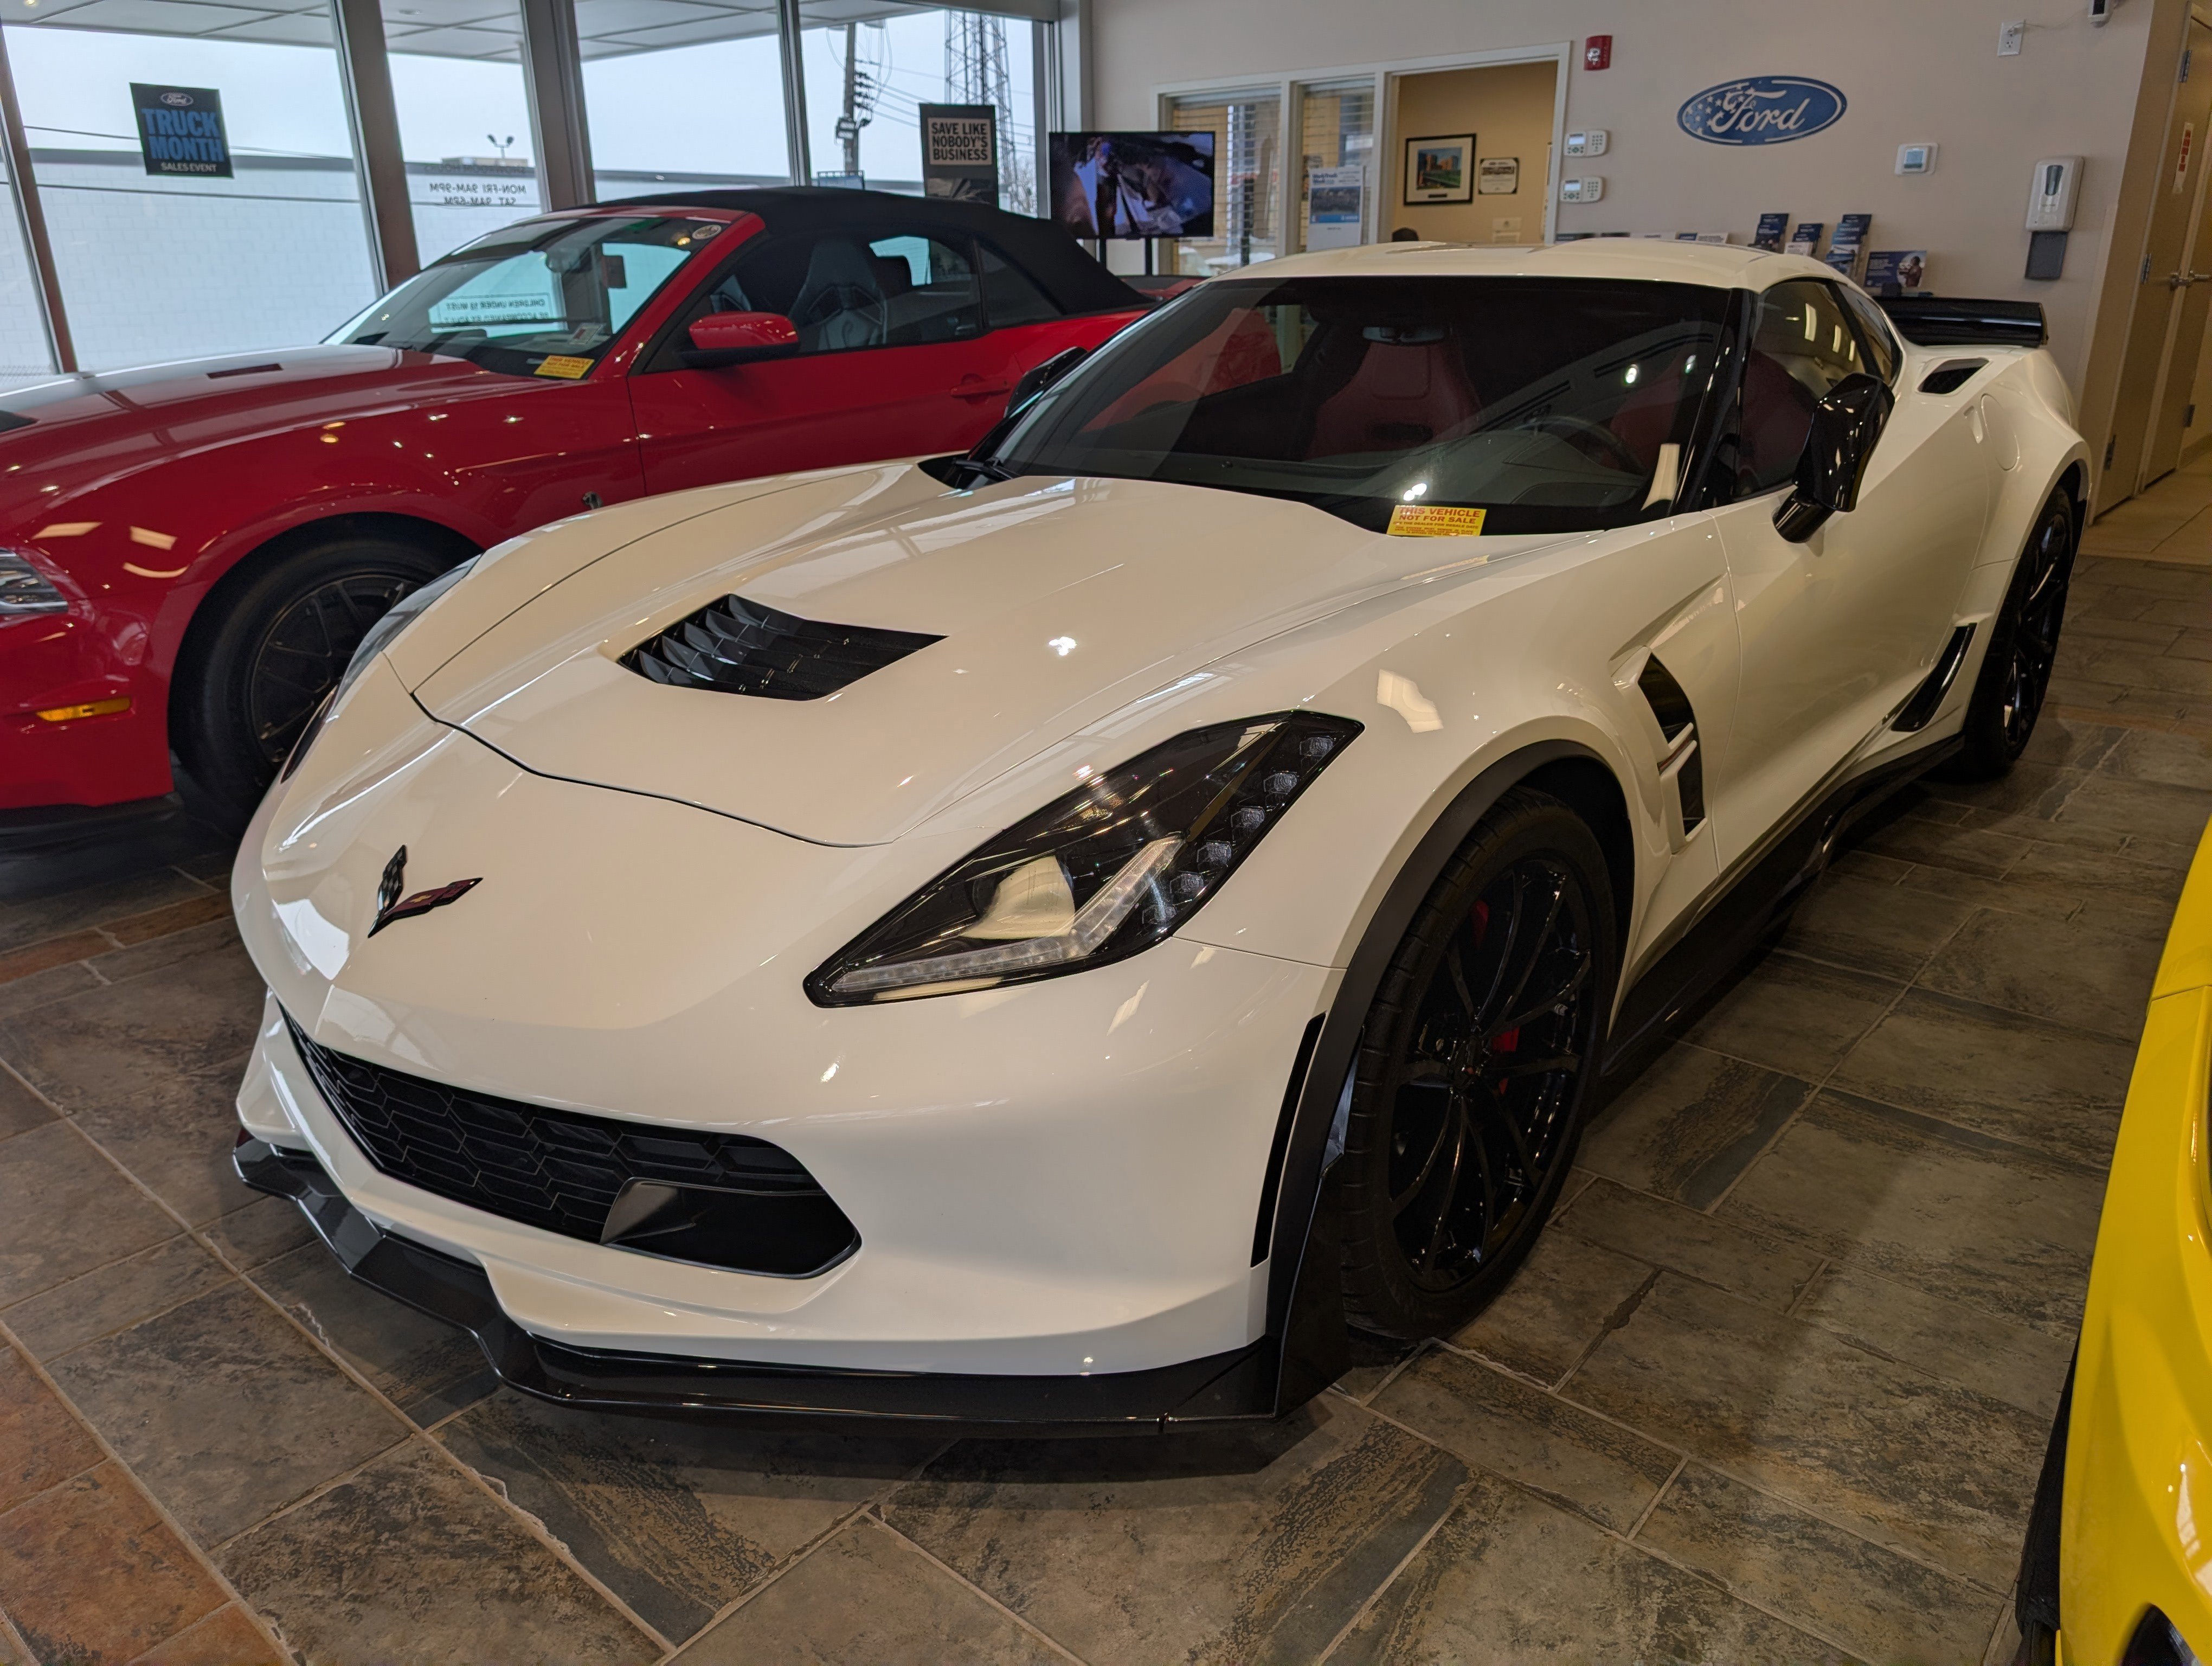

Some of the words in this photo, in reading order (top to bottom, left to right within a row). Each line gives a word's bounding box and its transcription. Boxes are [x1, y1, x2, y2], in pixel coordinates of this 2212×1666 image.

[1708, 87, 1810, 133] Ford
[141, 108, 220, 137] TRUCK
[931, 122, 959, 134] SAVE
[962, 123, 987, 135] LIKE
[933, 136, 988, 148] NOBODY'S
[148, 136, 224, 162] MONTH
[934, 148, 988, 161] BUSINESS
[160, 162, 189, 171] SALES
[189, 163, 216, 172] EVENT
[1429, 508, 1481, 518] VEHICLE
